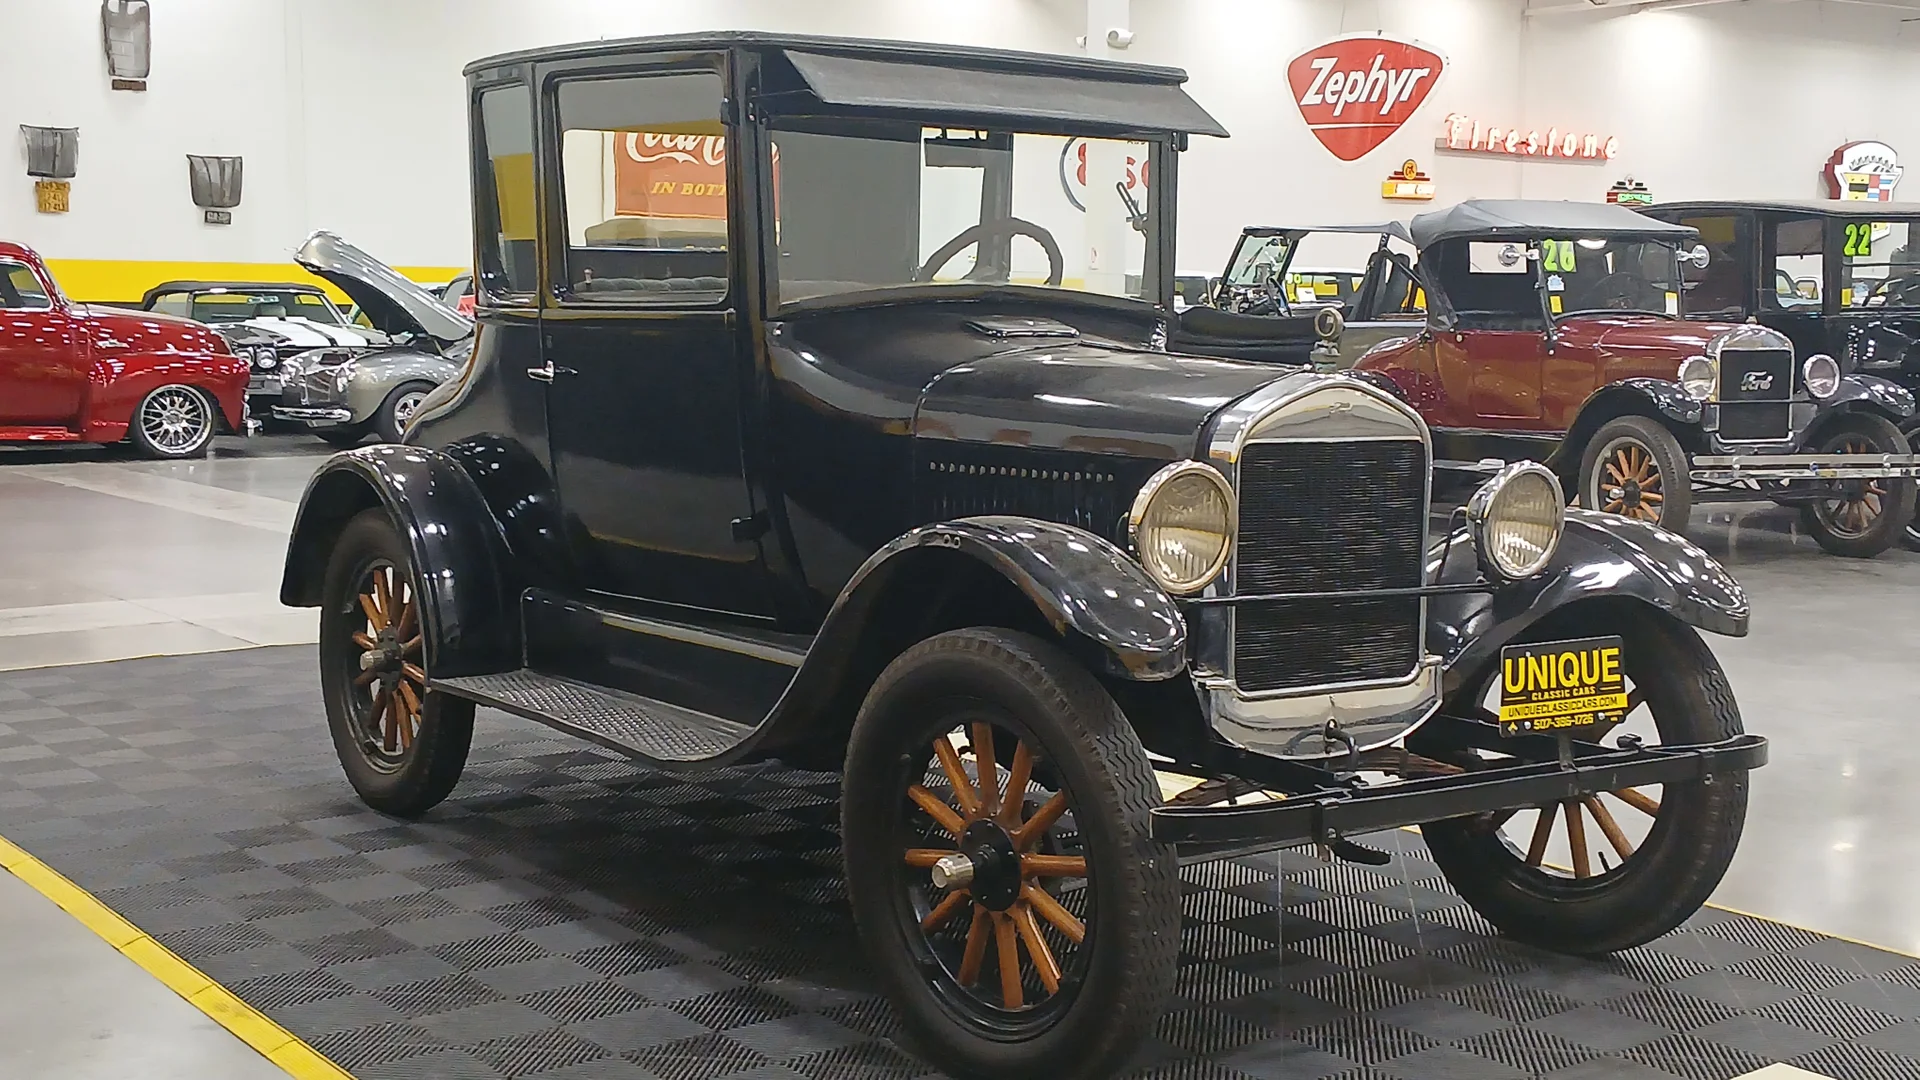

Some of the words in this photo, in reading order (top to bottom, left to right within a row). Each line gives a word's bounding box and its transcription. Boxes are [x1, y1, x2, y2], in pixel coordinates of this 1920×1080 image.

[1300, 54, 1431, 117] Zephyr
[1444, 112, 1620, 160] Firestone
[651, 181, 678, 195] IN
[681, 182, 727, 196] BOTT
[1543, 238, 1575, 272] 26
[1843, 223, 1871, 256] 22
[1504, 647, 1621, 694] UNIQUE
[1531, 689, 1571, 701] CLASSIC
[1572, 686, 1596, 697] CARS
